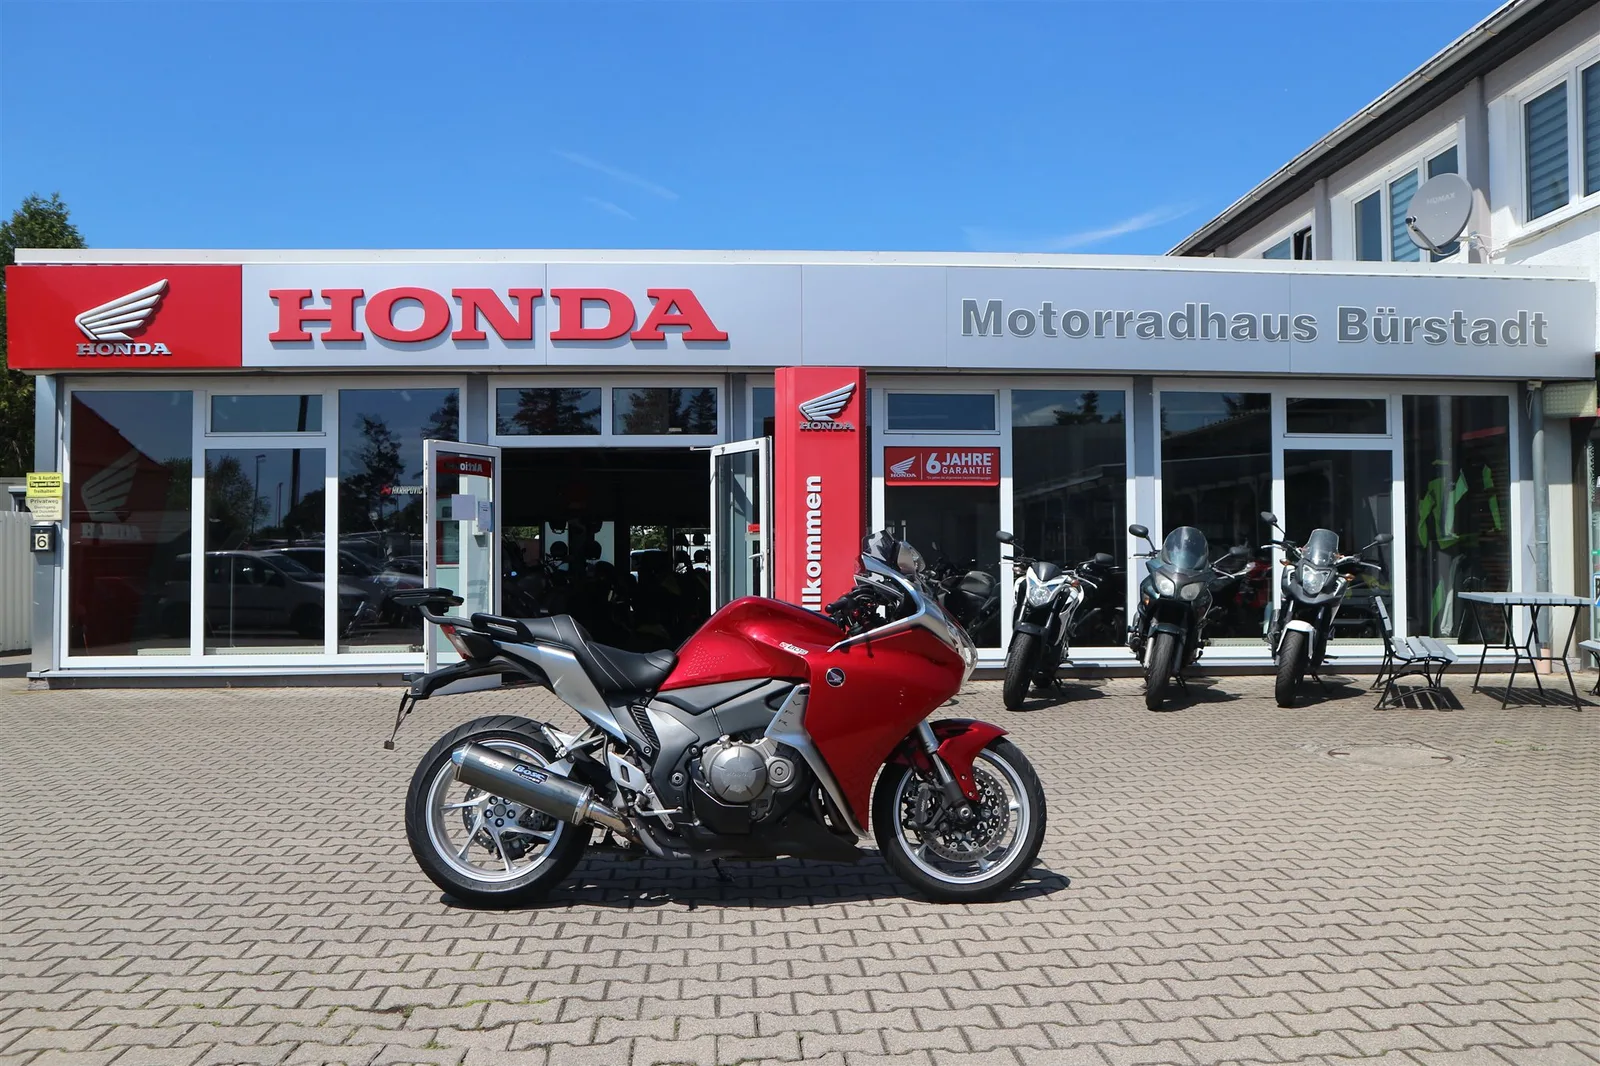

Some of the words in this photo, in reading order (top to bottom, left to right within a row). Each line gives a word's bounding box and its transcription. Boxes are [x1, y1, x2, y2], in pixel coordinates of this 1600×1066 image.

[269, 288, 727, 341] HONDA
[963, 300, 1318, 341] Motorradhaus
[1339, 306, 1548, 345] Bürstadt
[76, 343, 172, 356] HONDA
[799, 421, 856, 431] HONDA
[926, 452, 942, 474] 6
[942, 466, 992, 475] GARANTIE
[36, 535, 47, 548] 6
[801, 476, 822, 612] llkommen
